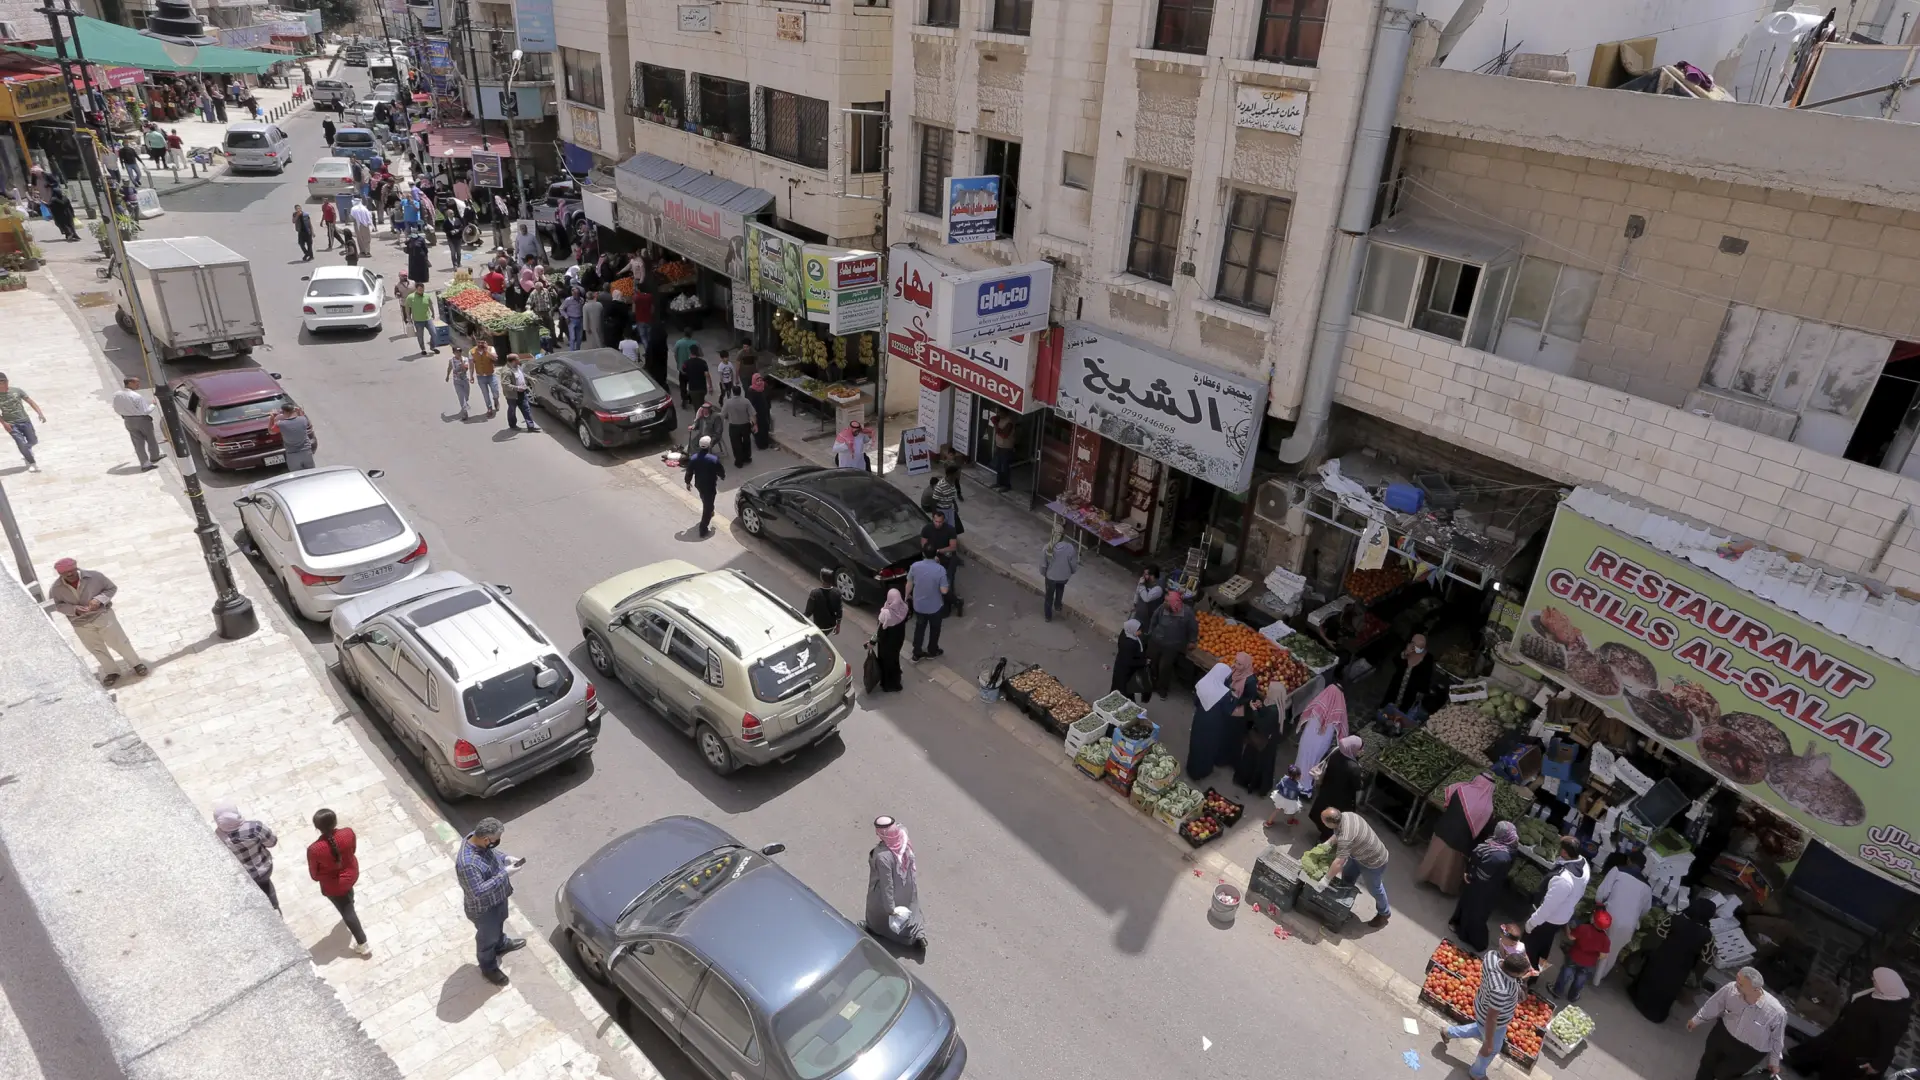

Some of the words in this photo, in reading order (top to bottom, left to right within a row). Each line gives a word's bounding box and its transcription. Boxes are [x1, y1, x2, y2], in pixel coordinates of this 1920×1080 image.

[809, 261, 822, 276] 2
[839, 262, 852, 278] بهاء
[852, 261, 876, 277] صيدلية
[892, 261, 933, 318] بهاء
[980, 282, 1028, 310] chicco
[973, 328, 996, 338] بهاء
[997, 321, 1031, 333] صيدلية
[929, 350, 1022, 405] Pharmacy
[1193, 372, 1221, 393] وعطارة
[1082, 356, 1223, 433] الشيخ
[1121, 407, 1177, 434] 0799446868
[906, 433, 926, 447] صيدلية
[909, 447, 928, 463] بهاء
[1587, 547, 1873, 698] RESTAURANT
[1547, 568, 1679, 650] GRILLS
[1674, 638, 1892, 768] AL-SALAL
